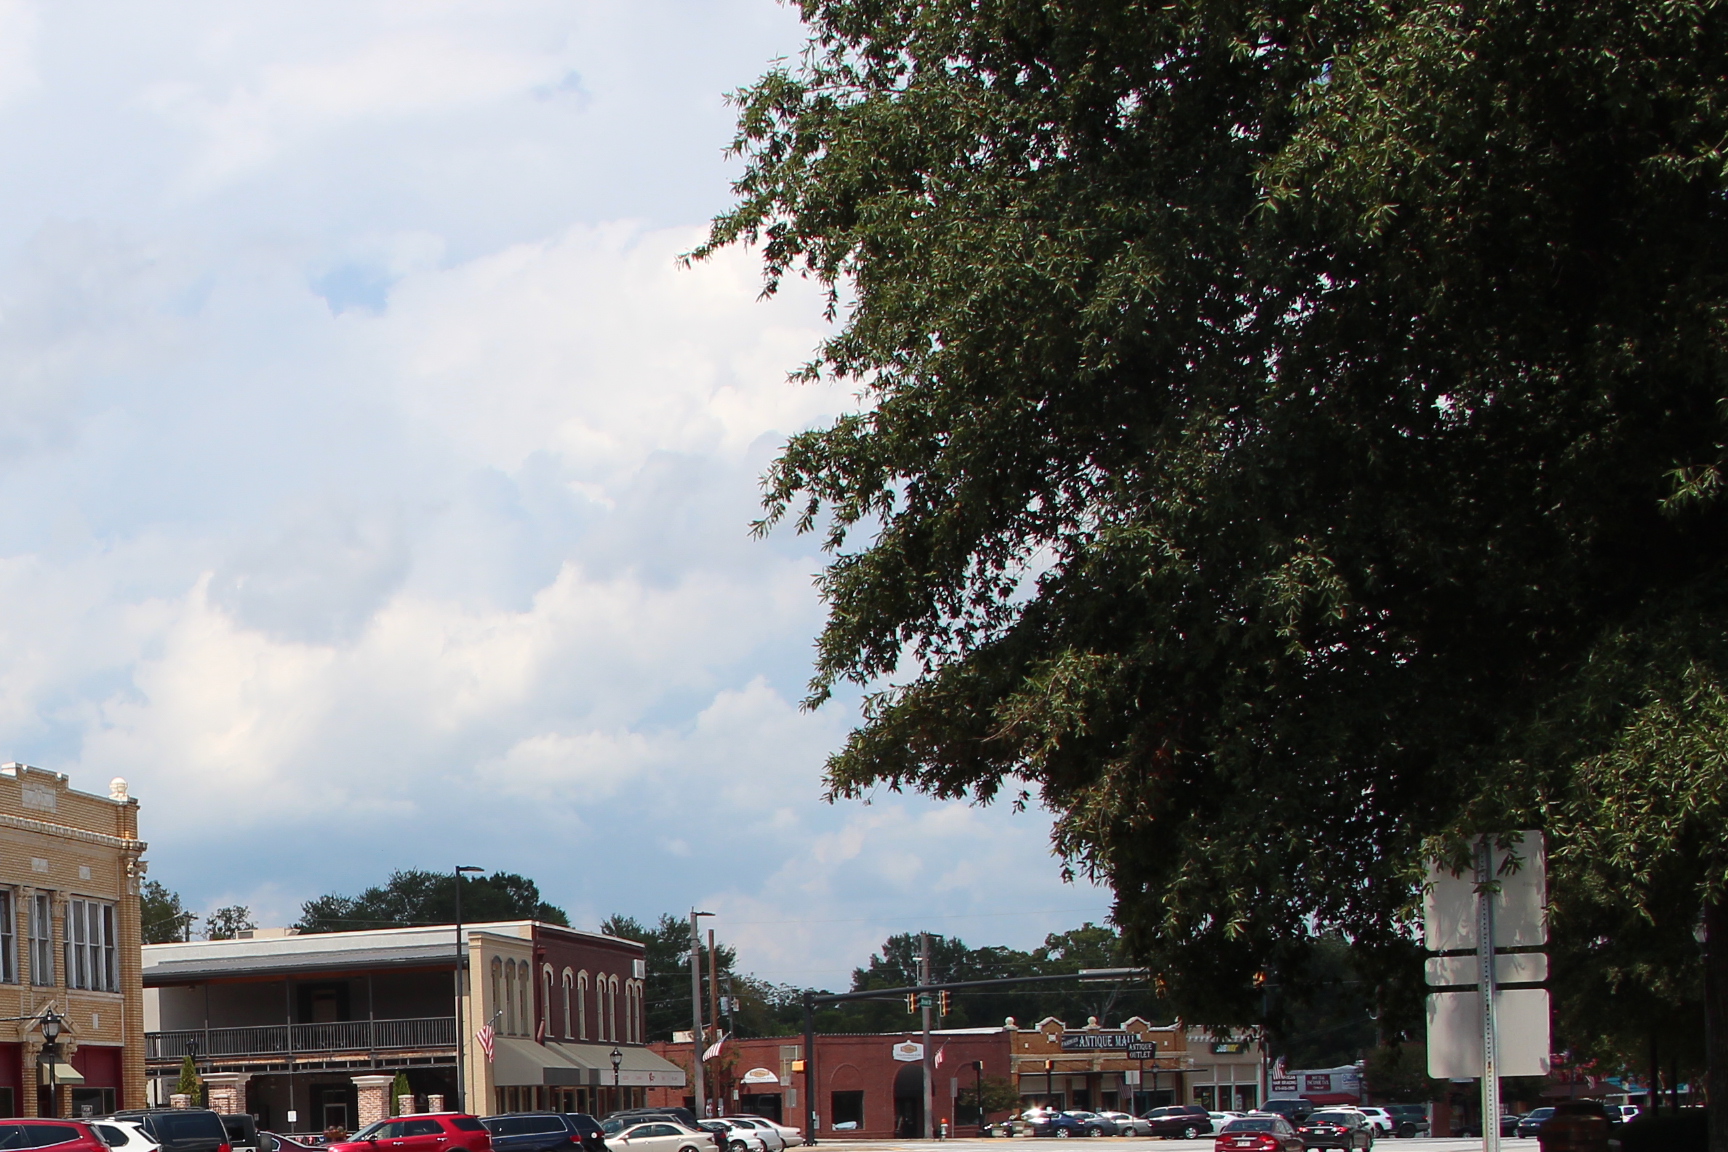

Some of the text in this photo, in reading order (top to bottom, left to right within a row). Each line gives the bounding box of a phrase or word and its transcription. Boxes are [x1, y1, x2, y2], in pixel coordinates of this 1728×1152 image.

[1079, 1035, 1113, 1048] ANTIQUE
[1128, 1043, 1152, 1051] ANTIQUE
[1129, 1051, 1151, 1059] OUTLET
